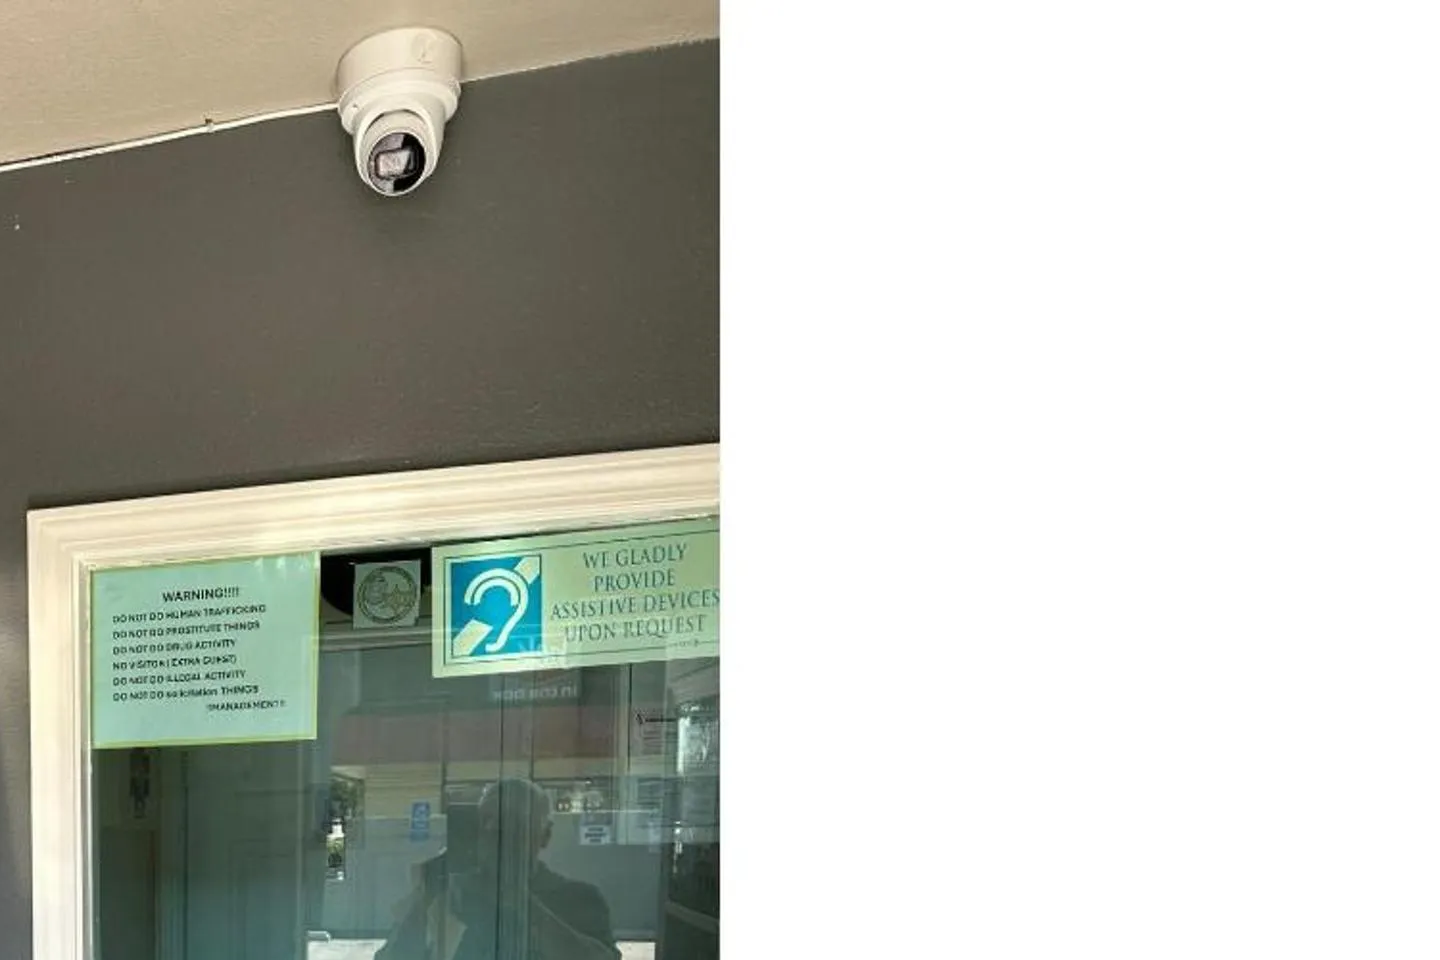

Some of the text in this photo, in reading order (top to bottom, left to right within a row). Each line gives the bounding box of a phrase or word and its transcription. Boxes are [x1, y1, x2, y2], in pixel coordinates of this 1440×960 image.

[582, 543, 687, 568] WE GLADLY
[594, 568, 676, 592] PROVIDE
[112, 603, 267, 623] DO NOT DO HUMAN TRAFFICKING
[551, 588, 720, 621] ASSISTIVE DEVICES
[112, 619, 260, 639] DO NOT DO PROSTITUTE THINGS
[565, 614, 708, 643] UPON REQUEST
[112, 638, 236, 656] DO NOT DO DRUG ACTIVITY
[112, 661, 128, 671] NO
[128, 659, 165, 669] VISITOR
[112, 676, 128, 686] DO
[128, 675, 148, 685] NOT
[149, 674, 164, 684] DO
[205, 668, 247, 681] ACTIVITY
[112, 692, 128, 702] DO
[129, 690, 148, 700] NOT
[149, 690, 164, 700] DO
[221, 684, 259, 695] THINGS
